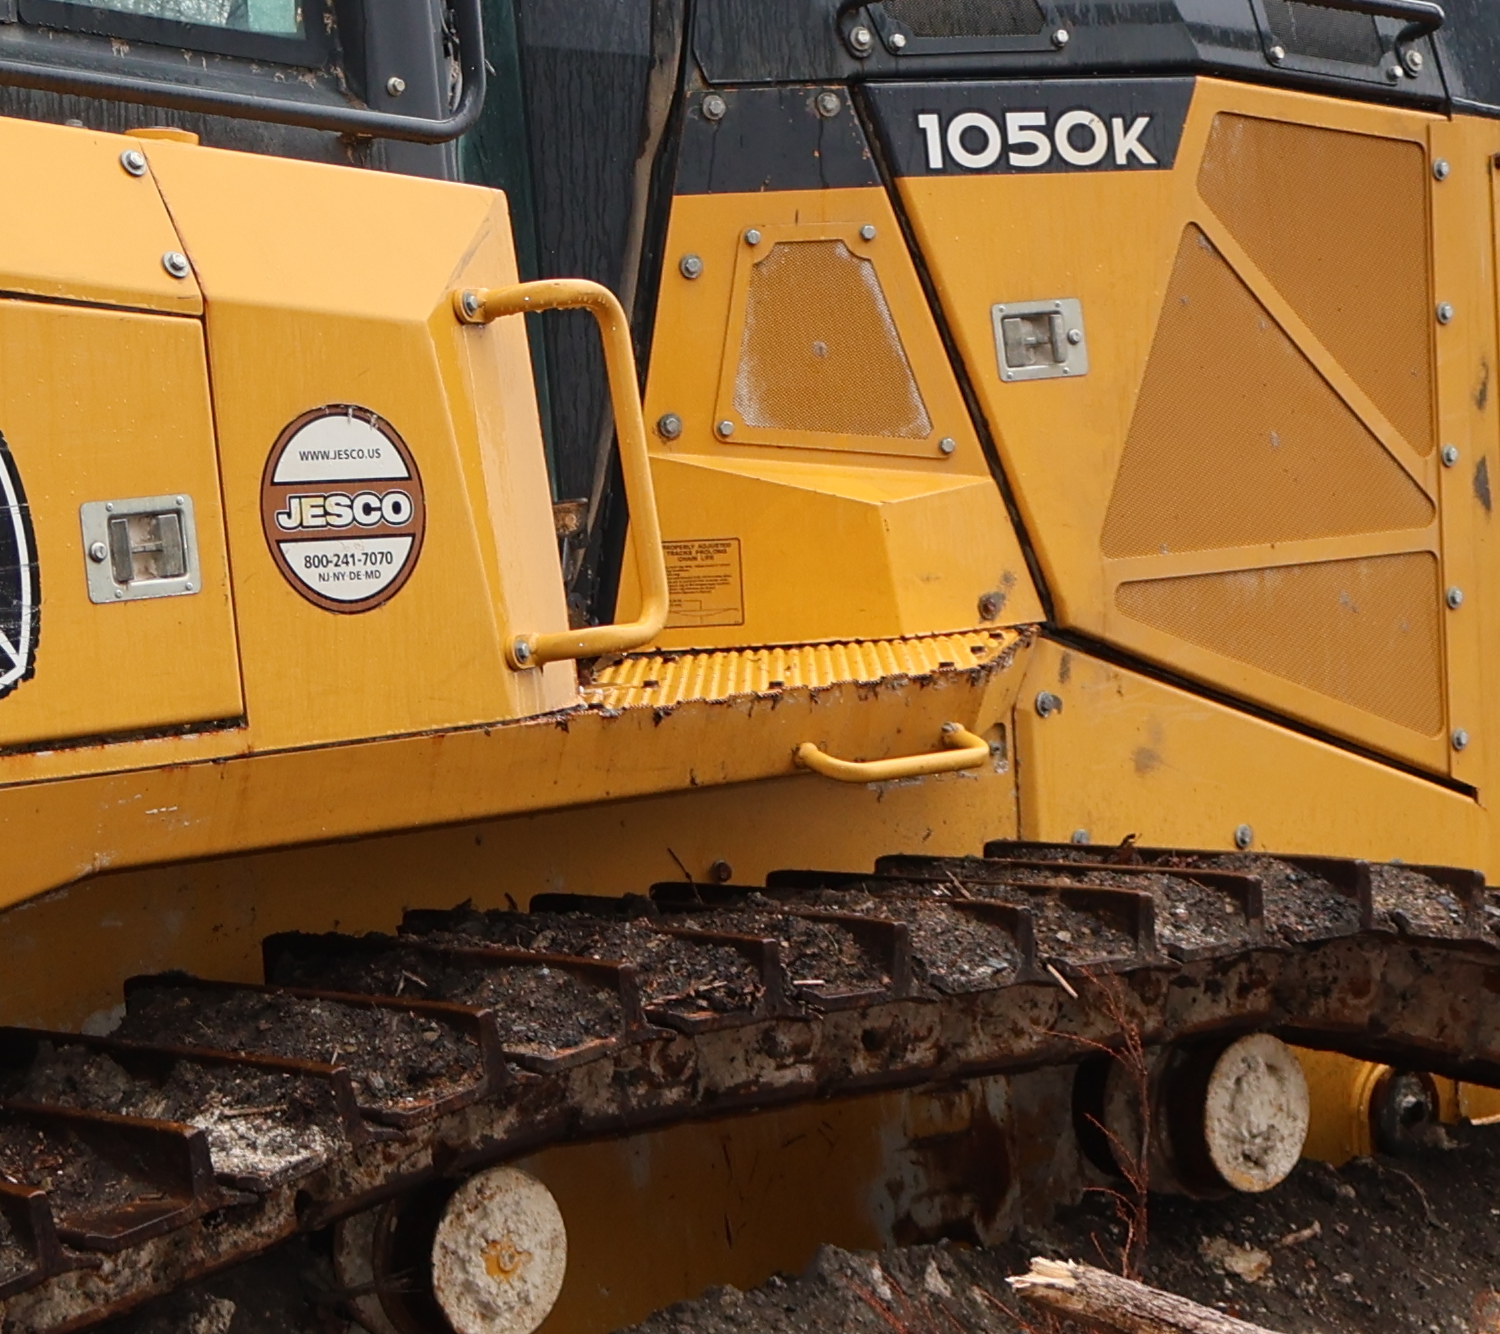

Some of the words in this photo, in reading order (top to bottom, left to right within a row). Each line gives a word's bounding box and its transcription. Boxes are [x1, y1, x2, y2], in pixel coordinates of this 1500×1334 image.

[918, 111, 1157, 169] 1050K
[299, 449, 381, 461] WWW.JESCO.US
[275, 490, 413, 531] JESCO
[304, 551, 393, 568] 800-241-7070
